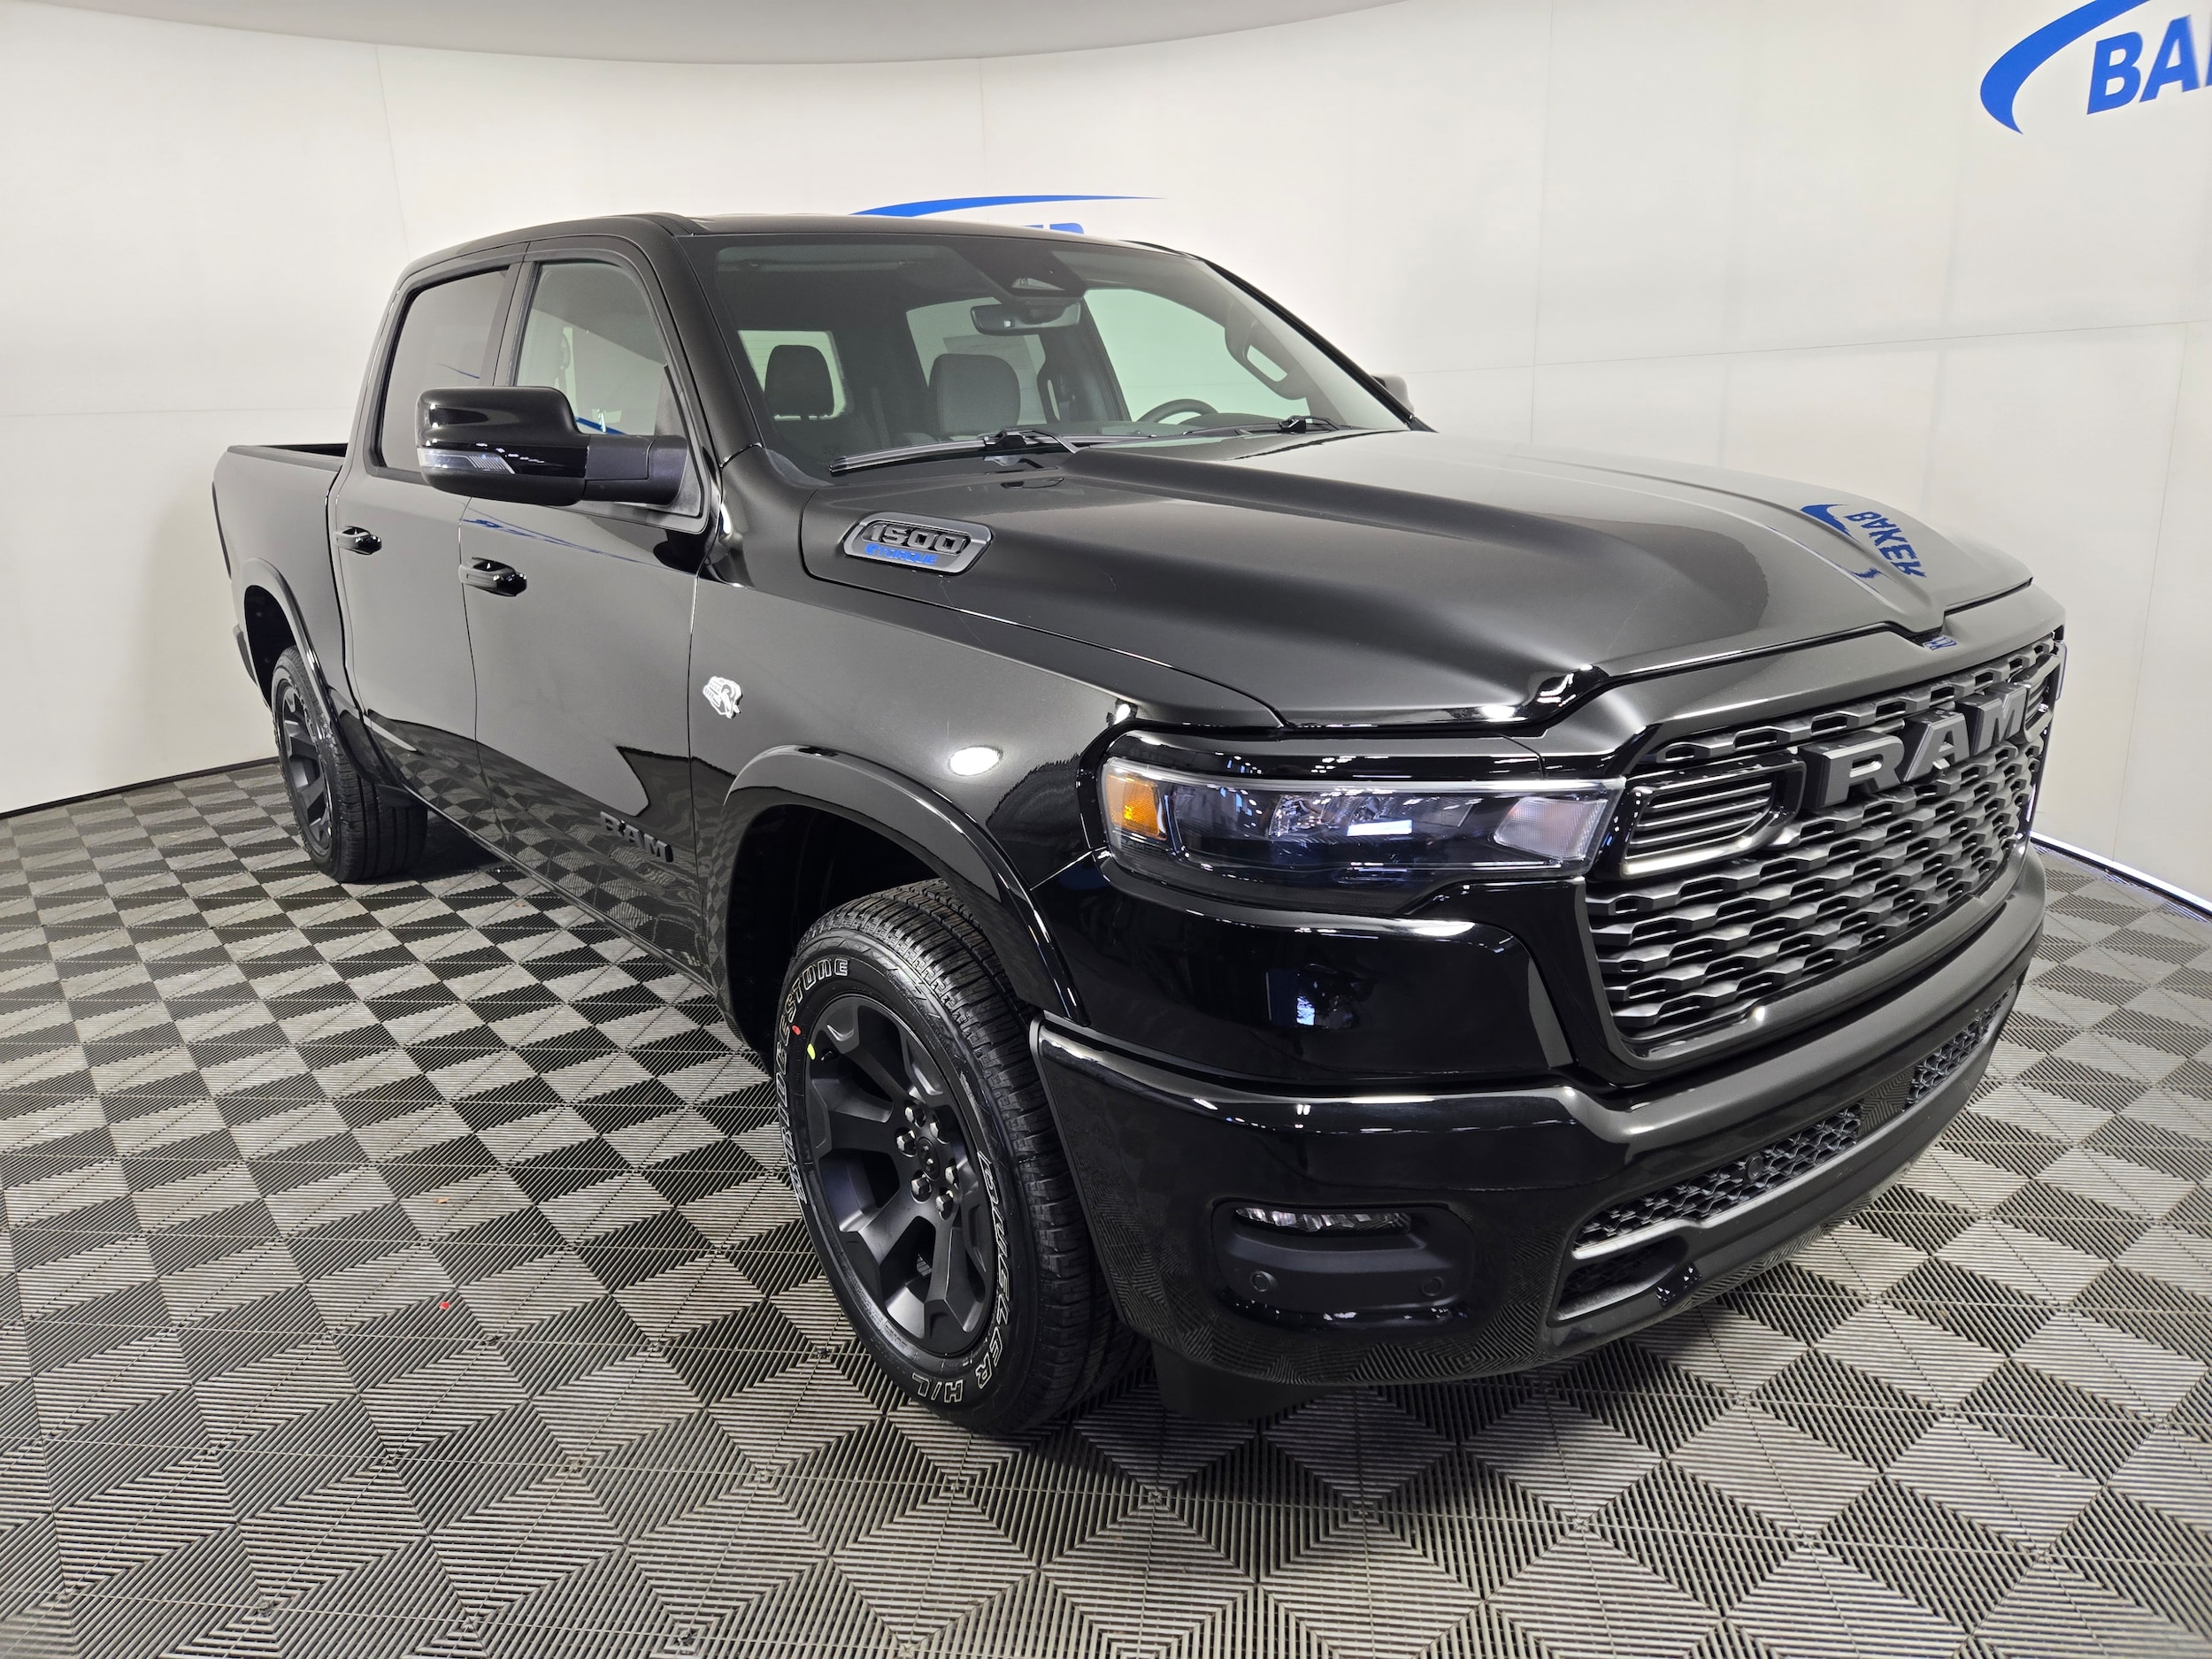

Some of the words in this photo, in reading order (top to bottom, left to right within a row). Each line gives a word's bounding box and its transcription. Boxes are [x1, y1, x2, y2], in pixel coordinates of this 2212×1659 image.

[871, 524, 967, 555] 1500
[1809, 682, 2028, 810] RAM
[600, 810, 673, 863] RAM
[775, 958, 849, 1204] BRIDGESTONE
[976, 1150, 1010, 1389] DUELER
[911, 1372, 964, 1403] H/L
